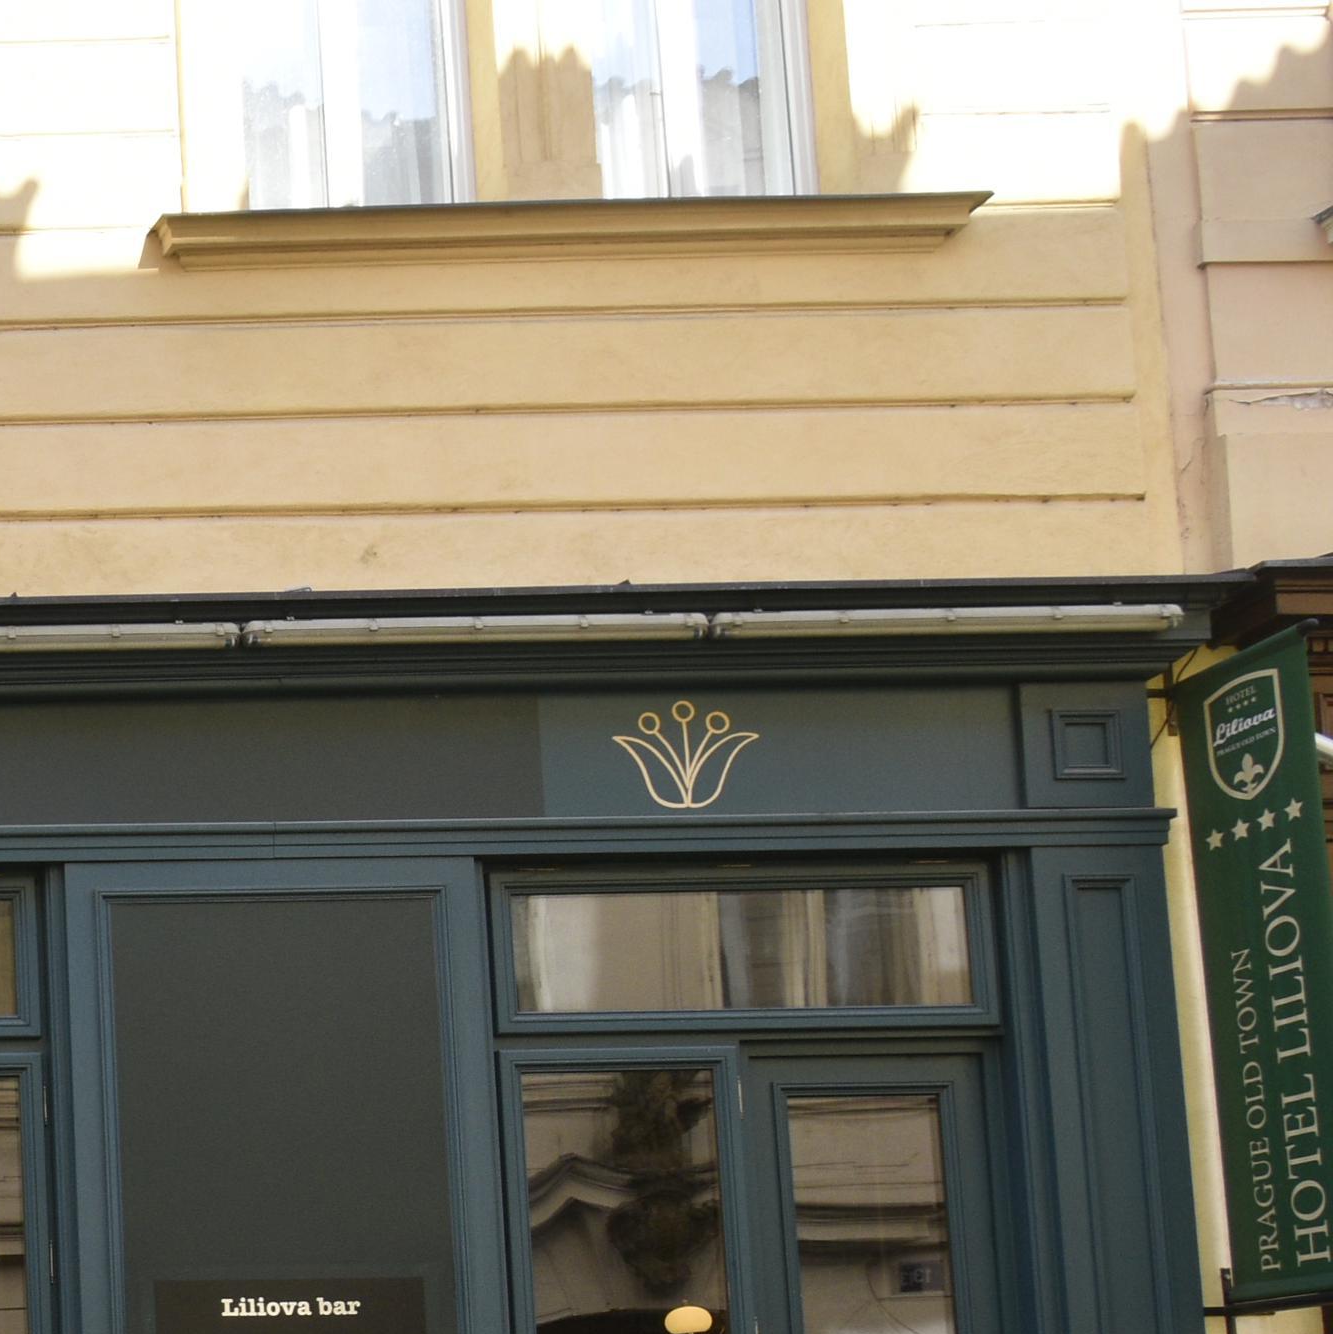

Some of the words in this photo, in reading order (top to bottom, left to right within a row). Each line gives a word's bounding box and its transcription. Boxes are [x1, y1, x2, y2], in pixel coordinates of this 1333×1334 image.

[1213, 707, 1276, 747] Liliova
[1231, 949, 1259, 1054] TOWN
[1258, 838, 1311, 1064] LILIOVA
[1243, 1061, 1267, 1129] OLD
[1249, 1137, 1281, 1272] PRAGUE
[1281, 1073, 1331, 1267] HOTEL
[221, 1297, 312, 1317] Liliova
[316, 1297, 361, 1316] bar
